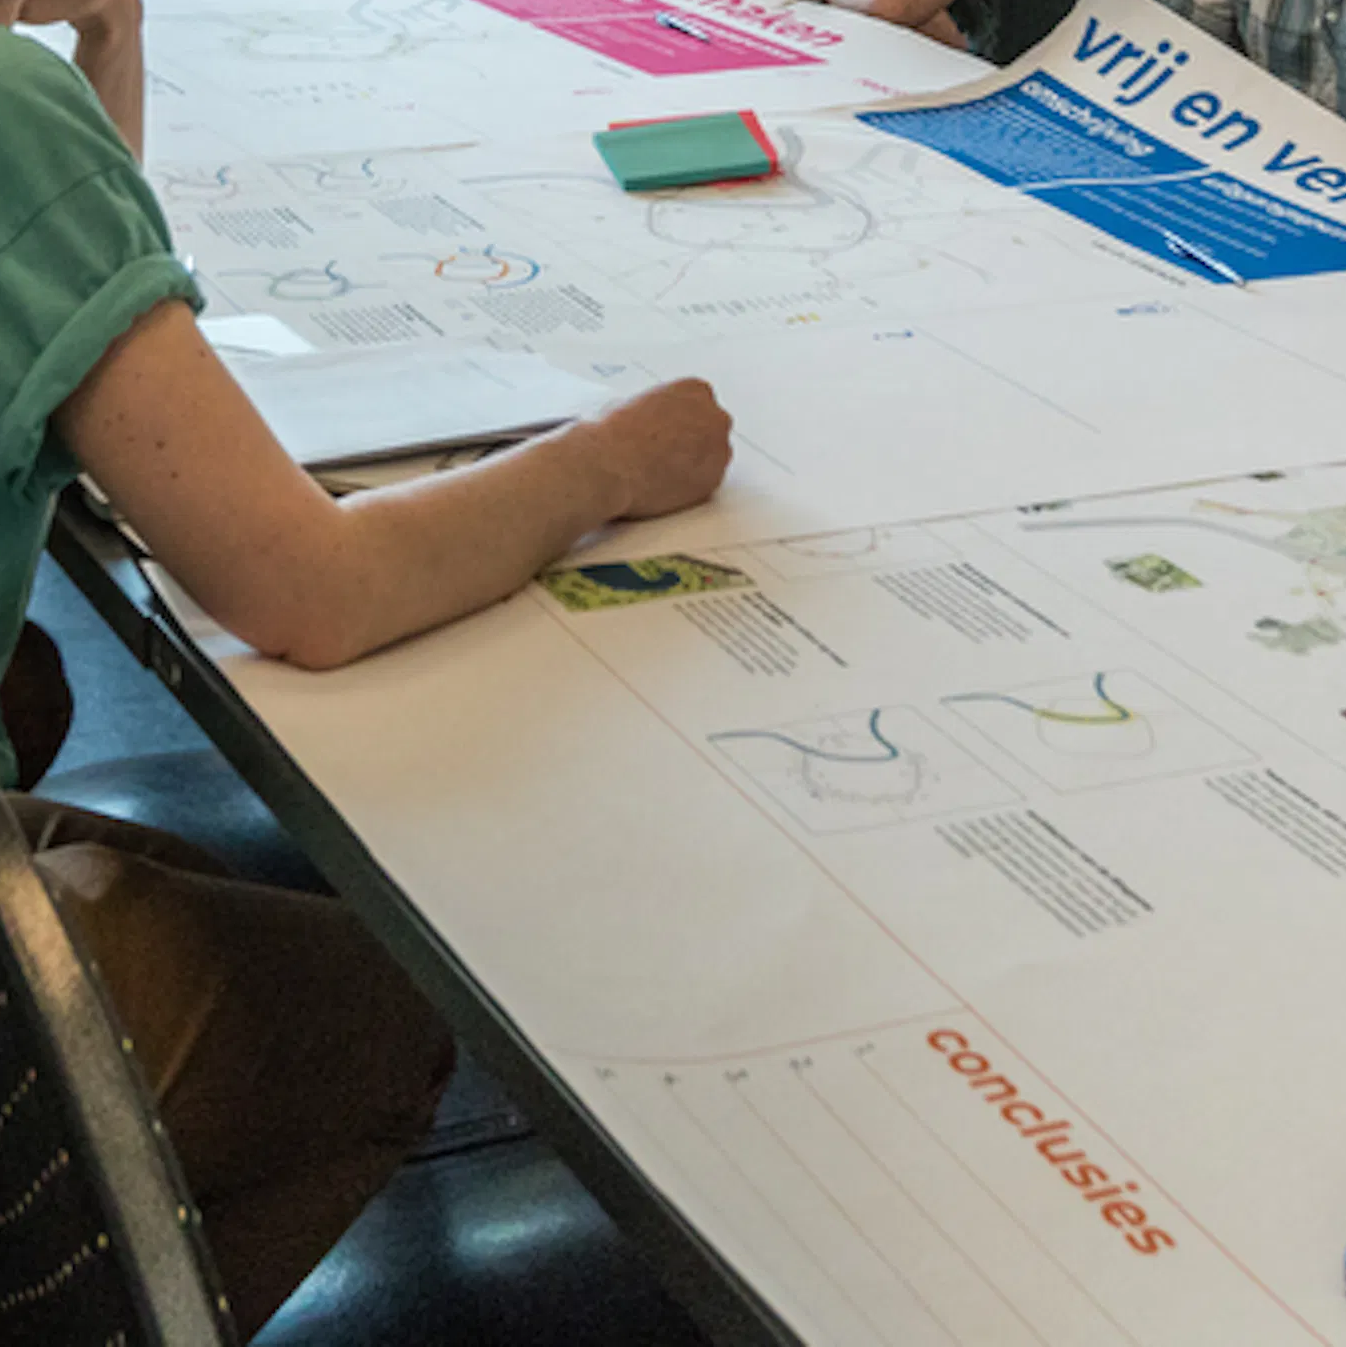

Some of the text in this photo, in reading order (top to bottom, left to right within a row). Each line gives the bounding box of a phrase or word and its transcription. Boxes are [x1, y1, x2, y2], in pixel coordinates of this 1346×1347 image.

[1070, 15, 1190, 106] vrij
[1171, 80, 1262, 151] en
[926, 1026, 1177, 1257] conclusies
